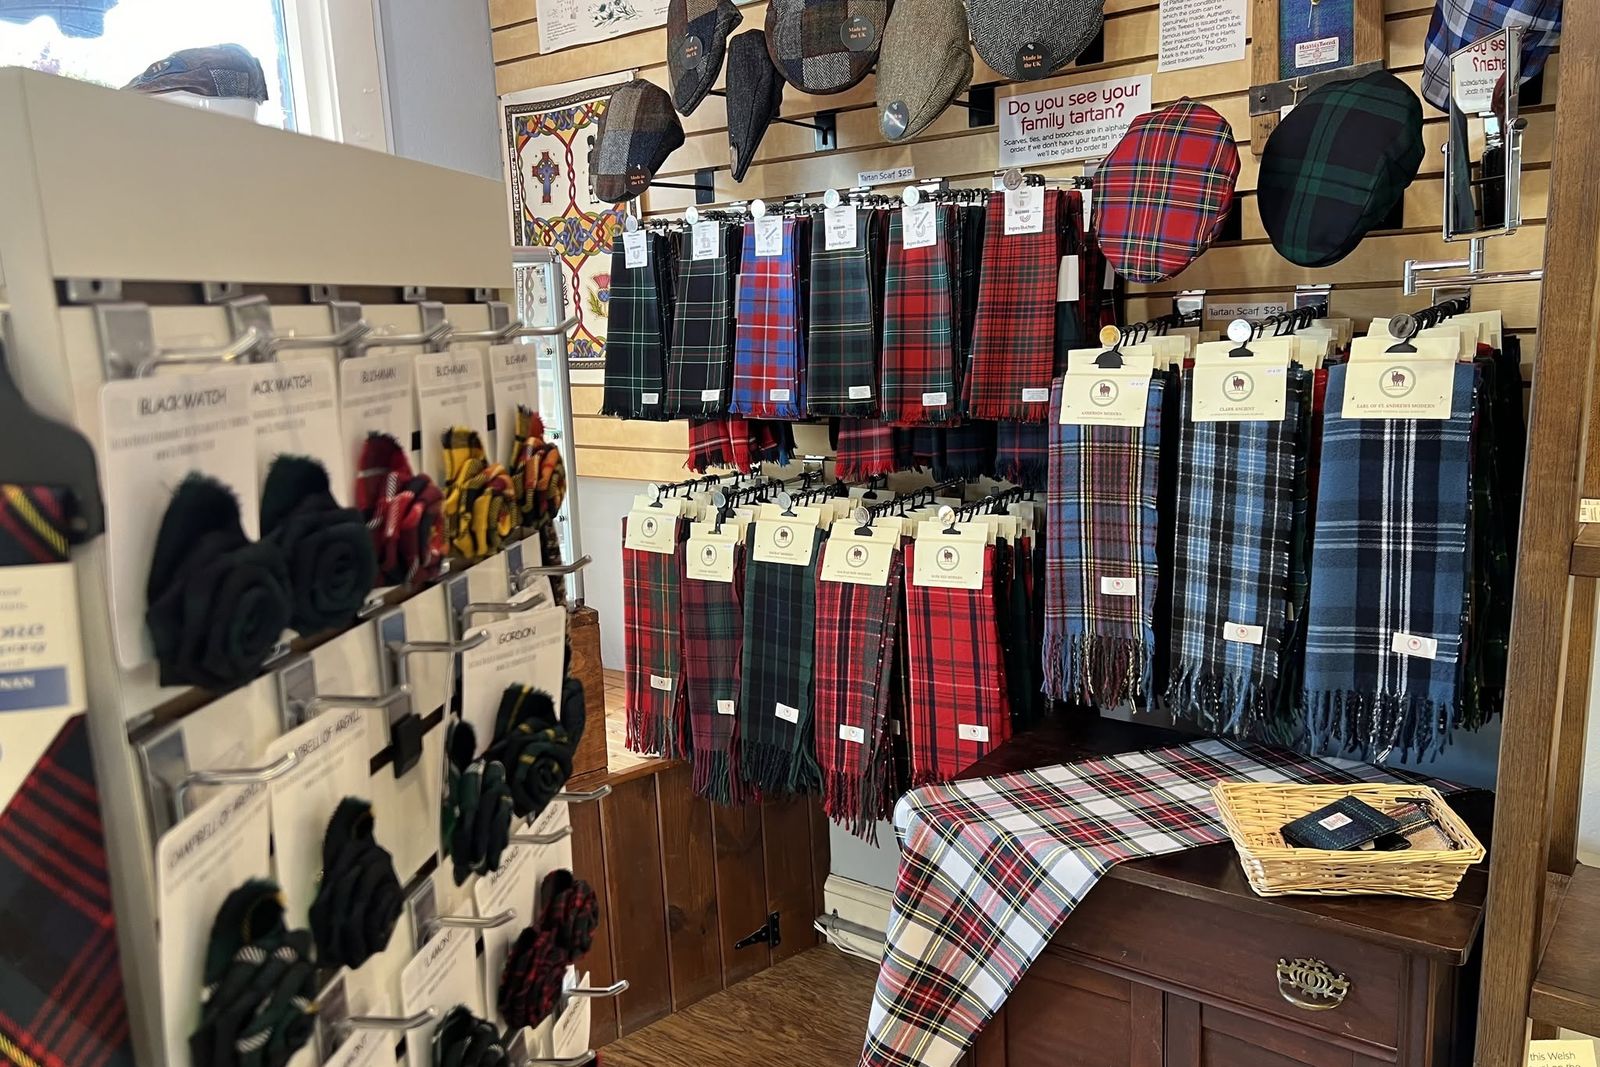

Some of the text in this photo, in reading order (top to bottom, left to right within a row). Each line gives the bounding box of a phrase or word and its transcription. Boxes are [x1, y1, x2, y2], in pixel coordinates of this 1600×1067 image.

[1163, 17, 1188, 27] genuinely
[1207, 9, 1232, 18] Authentic
[1174, 36, 1200, 44] inspection
[1208, 44, 1236, 52] Kingdom's
[1008, 83, 1141, 115] Do you see your
[1021, 102, 1124, 135] family tartan?
[1004, 137, 1027, 146] Scarves,
[1055, 130, 1084, 139] brooches
[1042, 140, 1057, 149] don't
[1060, 146, 1074, 155] glad
[880, 171, 895, 179] Scarf
[898, 169, 912, 177] $29
[1237, 307, 1259, 316] Scarf
[1264, 306, 1284, 314] $29
[362, 367, 397, 384] BUCHANAN
[436, 364, 469, 377] BUCHANAN
[253, 374, 312, 395] ACK WATCH
[140, 388, 227, 416] BLACK WATCH
[499, 626, 536, 644] GORDON
[168, 820, 217, 869] CAMPBELL
[1530, 1051, 1576, 1061] this Welsh
